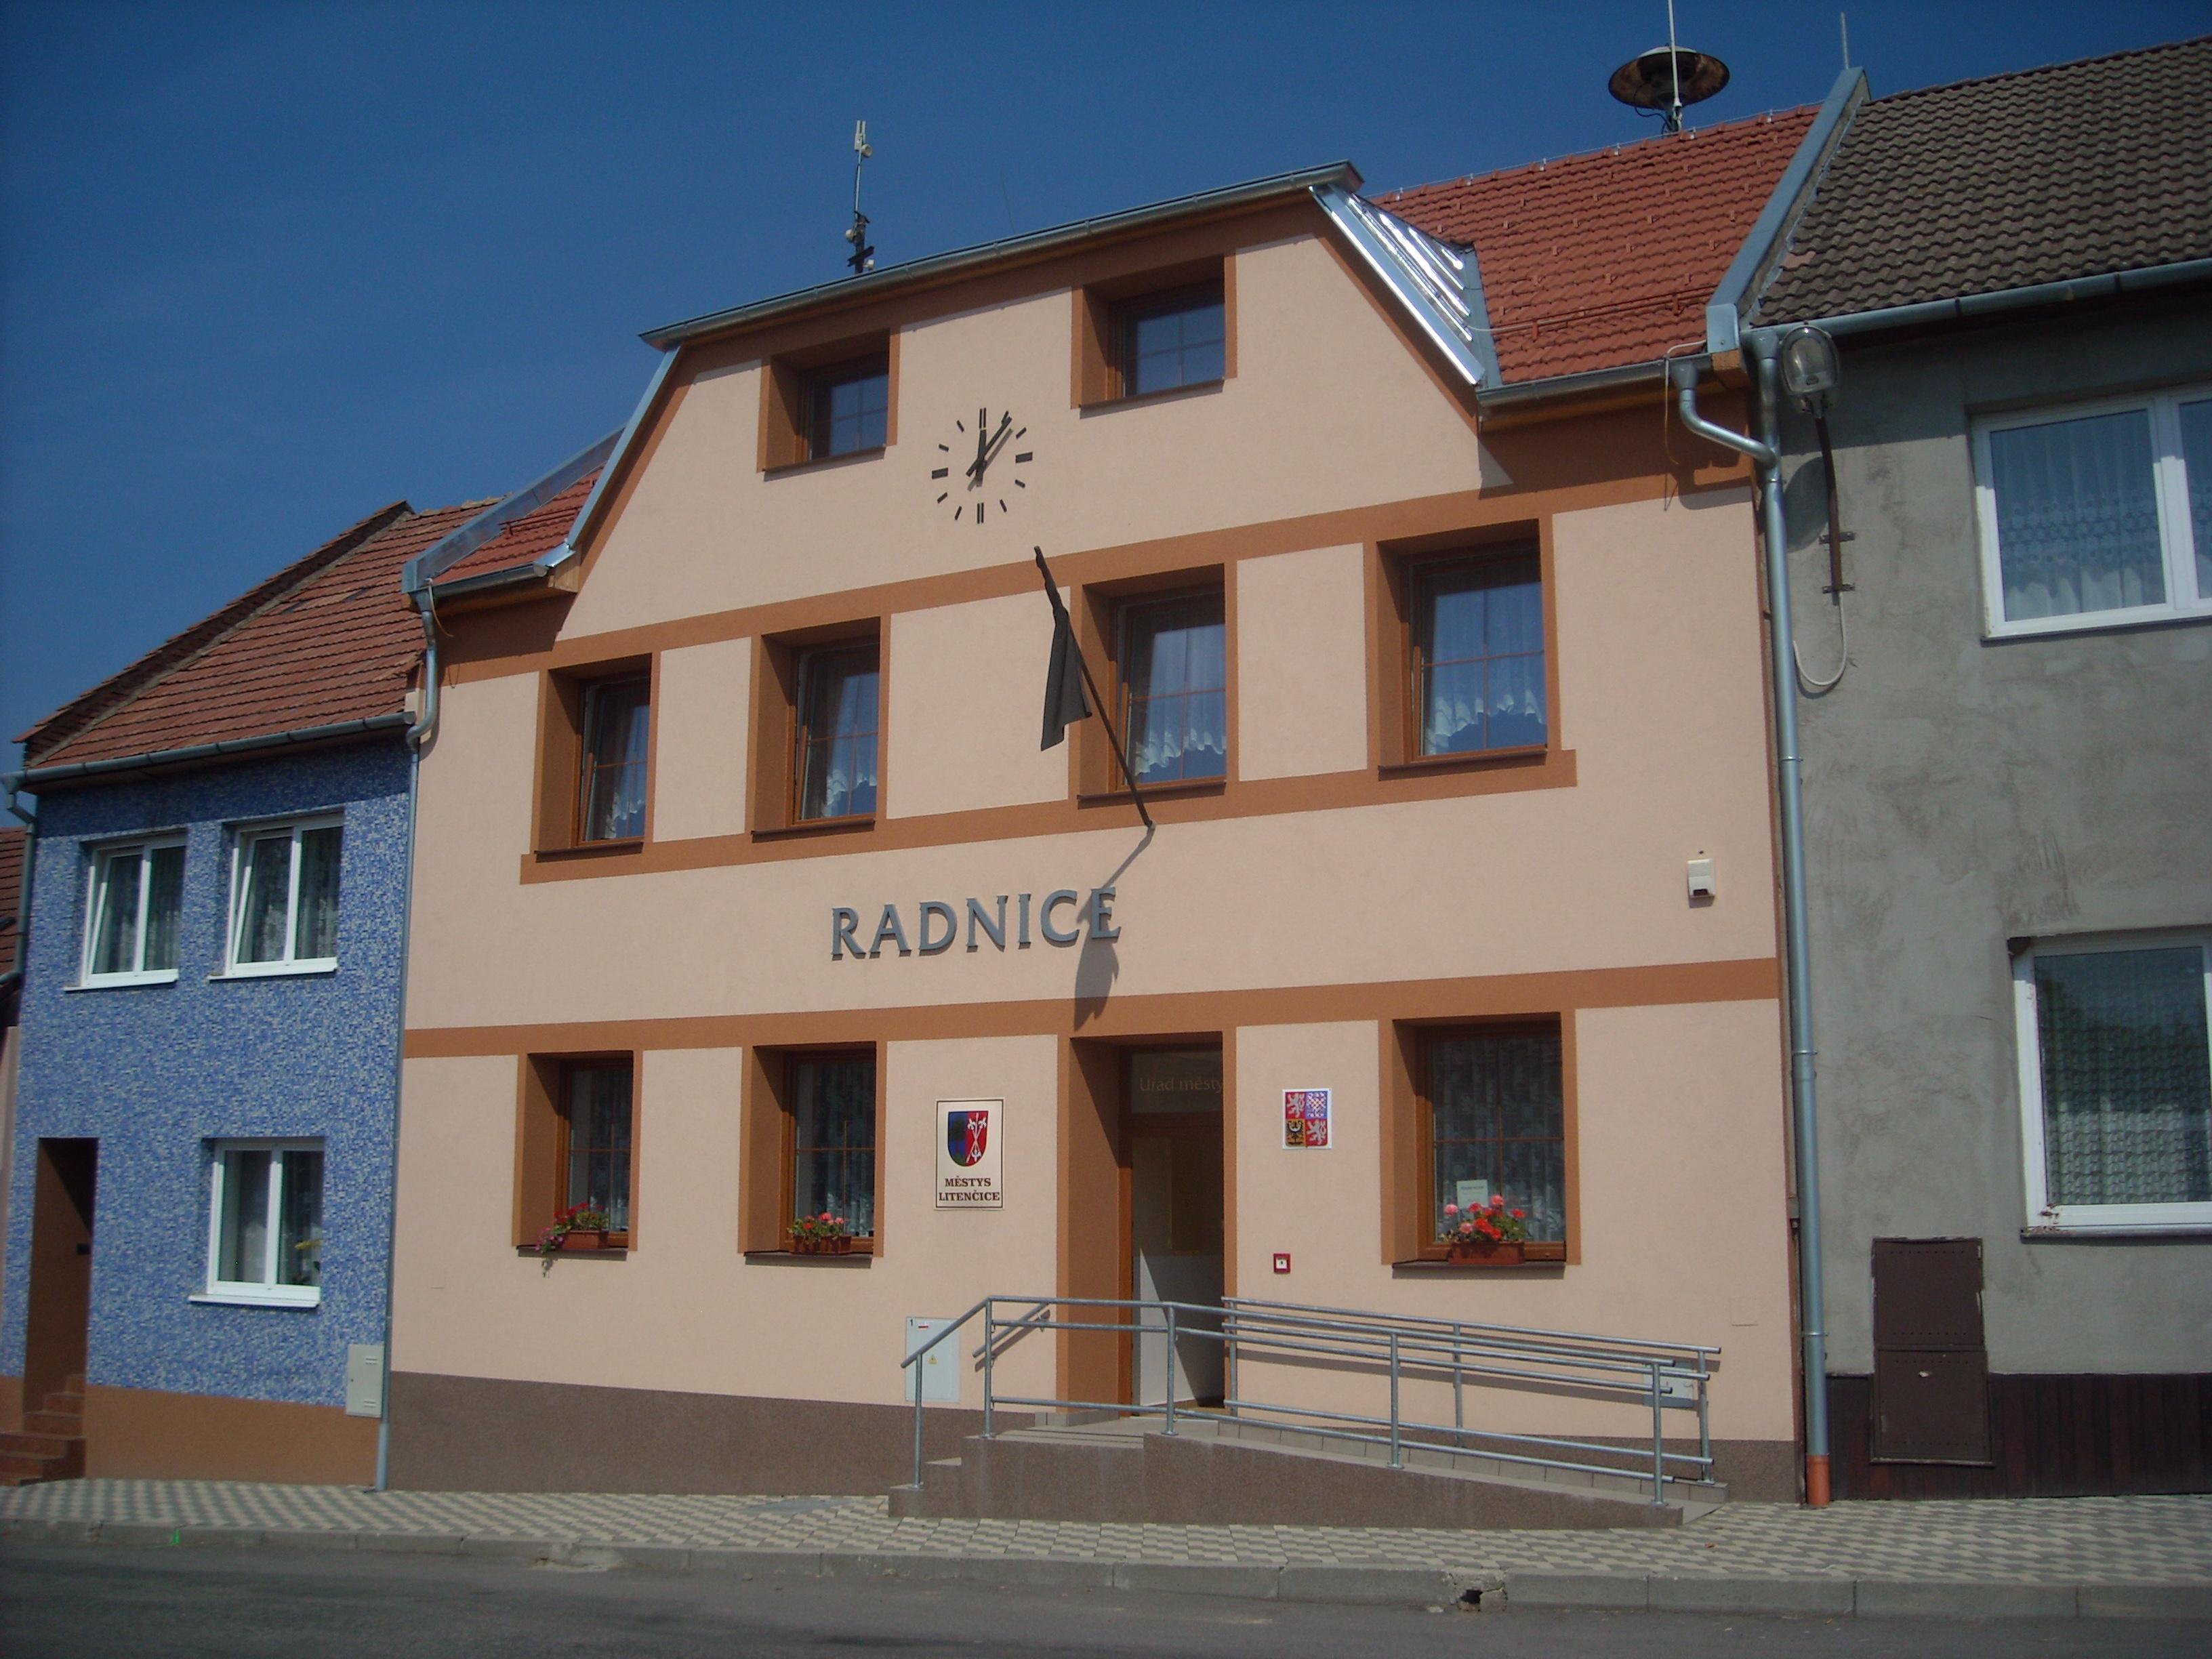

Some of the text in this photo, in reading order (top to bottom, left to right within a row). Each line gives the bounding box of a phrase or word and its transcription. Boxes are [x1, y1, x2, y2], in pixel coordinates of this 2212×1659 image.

[831, 886, 1122, 960] RADNICE
[945, 1176, 991, 1187] MĚSTYS
[939, 1190, 1000, 1201] LITENČICE
